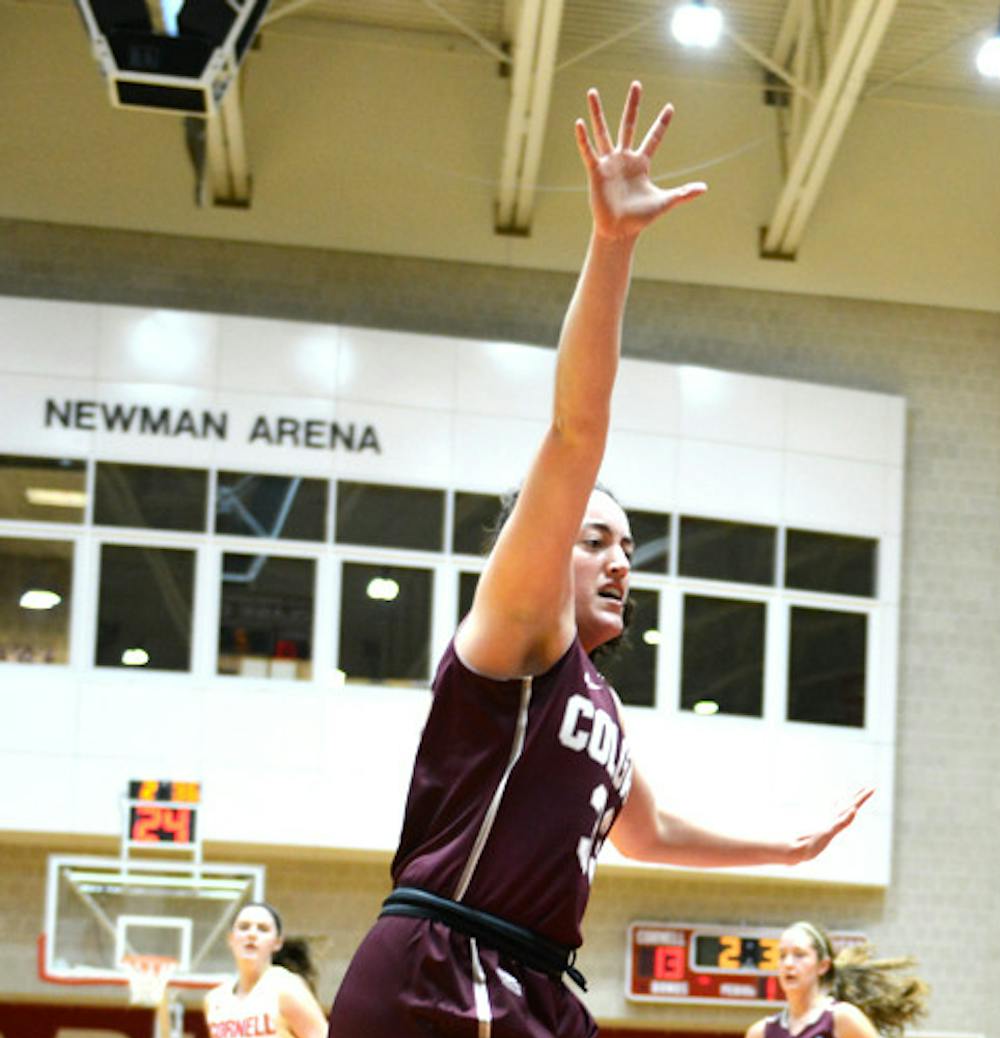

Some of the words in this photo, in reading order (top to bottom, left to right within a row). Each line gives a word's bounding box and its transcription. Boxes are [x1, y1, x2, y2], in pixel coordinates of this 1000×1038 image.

[44, 398, 228, 441] NEWMAN
[248, 414, 382, 455] ARENA
[131, 806, 190, 843] 24
